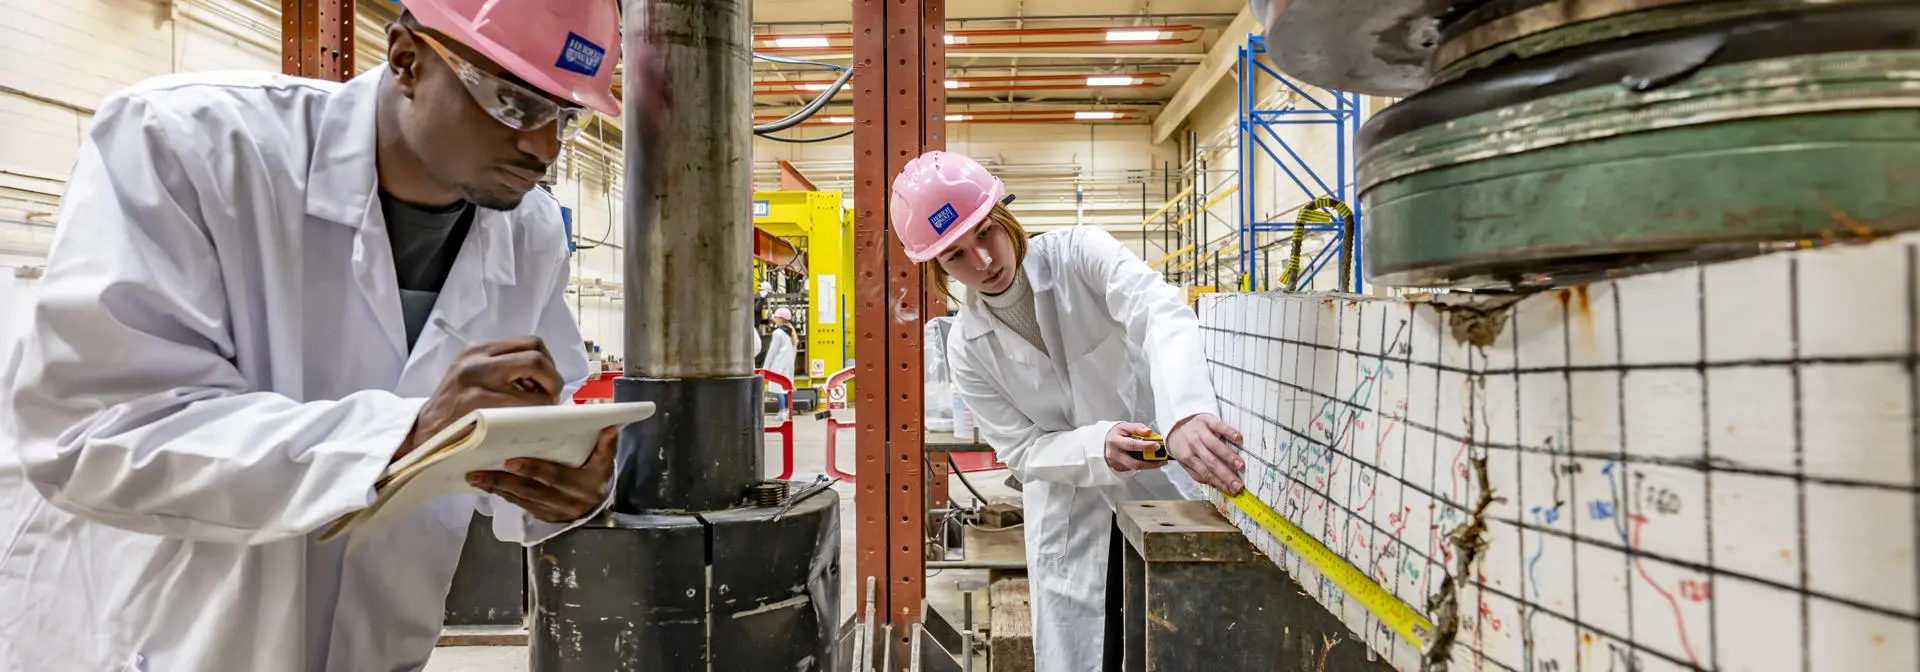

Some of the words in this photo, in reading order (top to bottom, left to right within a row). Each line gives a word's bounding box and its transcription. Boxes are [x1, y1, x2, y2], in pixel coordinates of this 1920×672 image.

[569, 38, 603, 62] HERIOT
[576, 51, 600, 68] WATT
[930, 206, 951, 224] HERIOT
[939, 210, 954, 224] WATT
